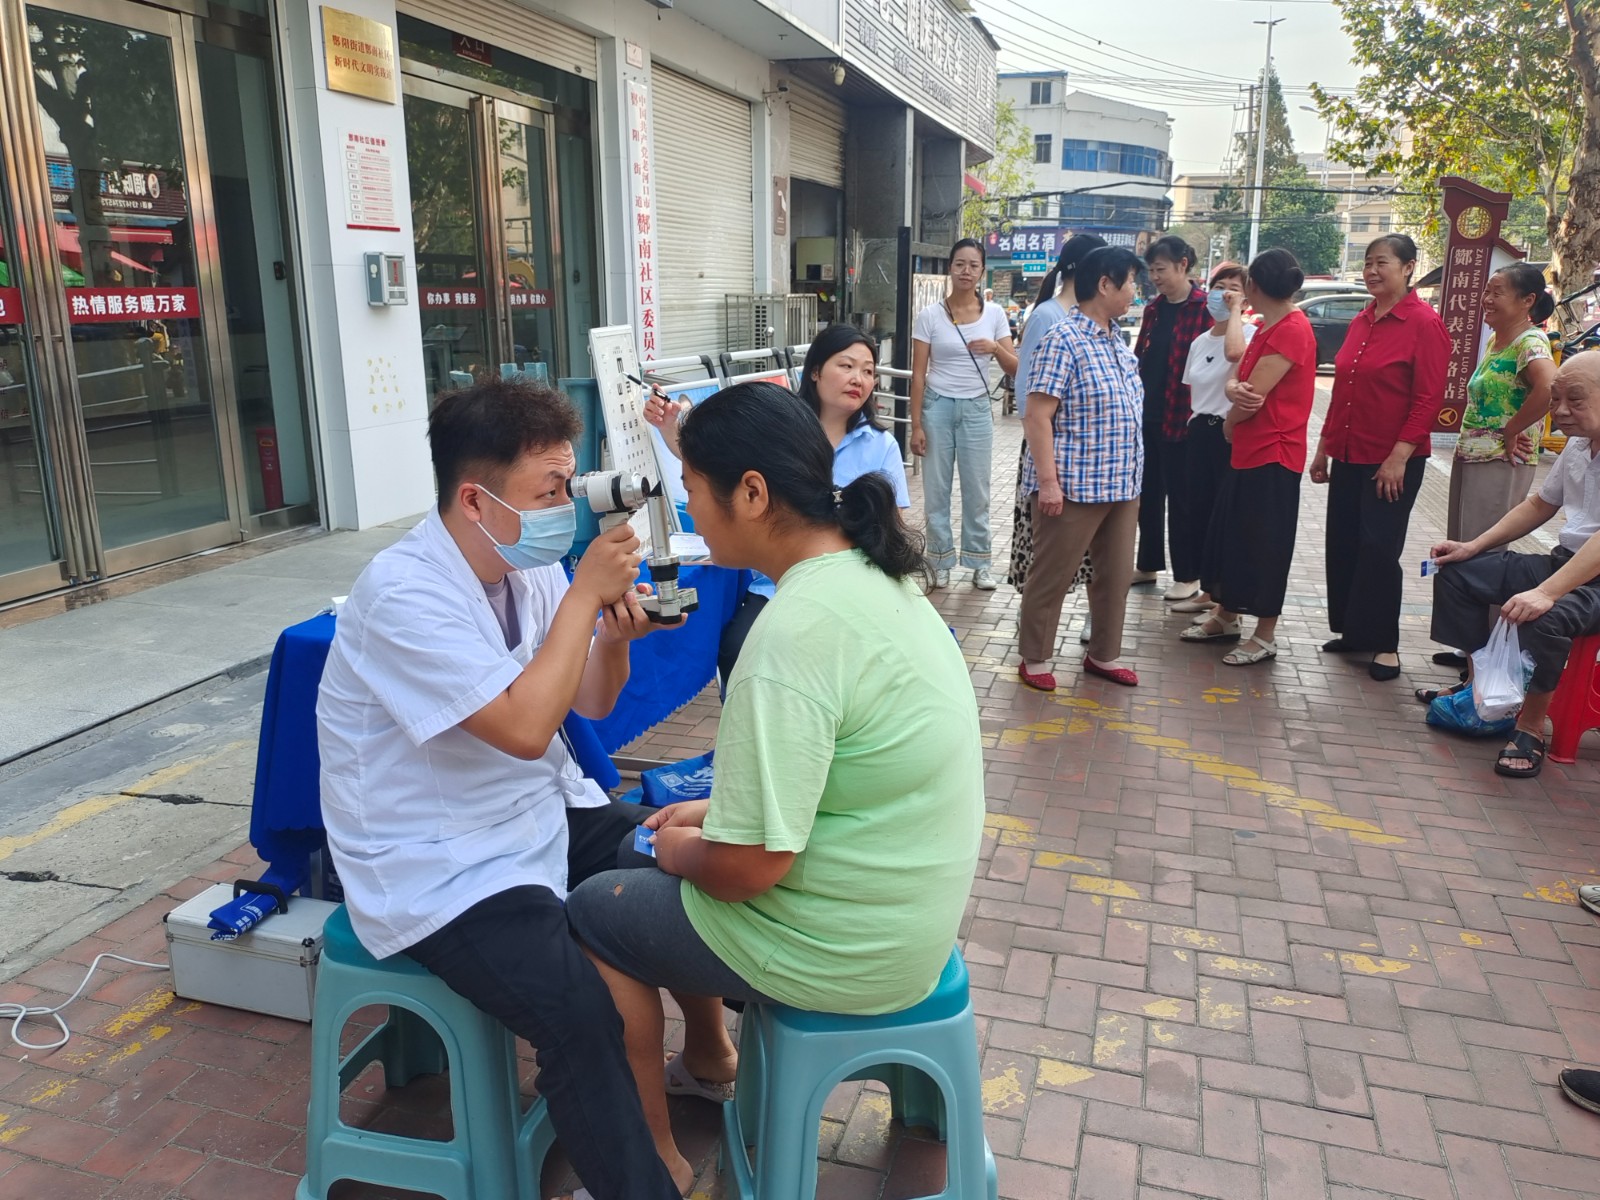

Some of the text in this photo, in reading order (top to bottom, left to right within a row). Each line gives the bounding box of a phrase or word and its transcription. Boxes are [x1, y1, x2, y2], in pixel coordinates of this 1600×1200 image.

[998, 232, 1056, 252] 名烟名酒
[72, 294, 187, 316] 热情服务暖万家
[427, 292, 477, 305] 你办事 我服务
[529, 293, 547, 305] 你放心
[1457, 248, 1484, 400] ZAN NAN DAI BIAO LIAN LUO ZHAN
